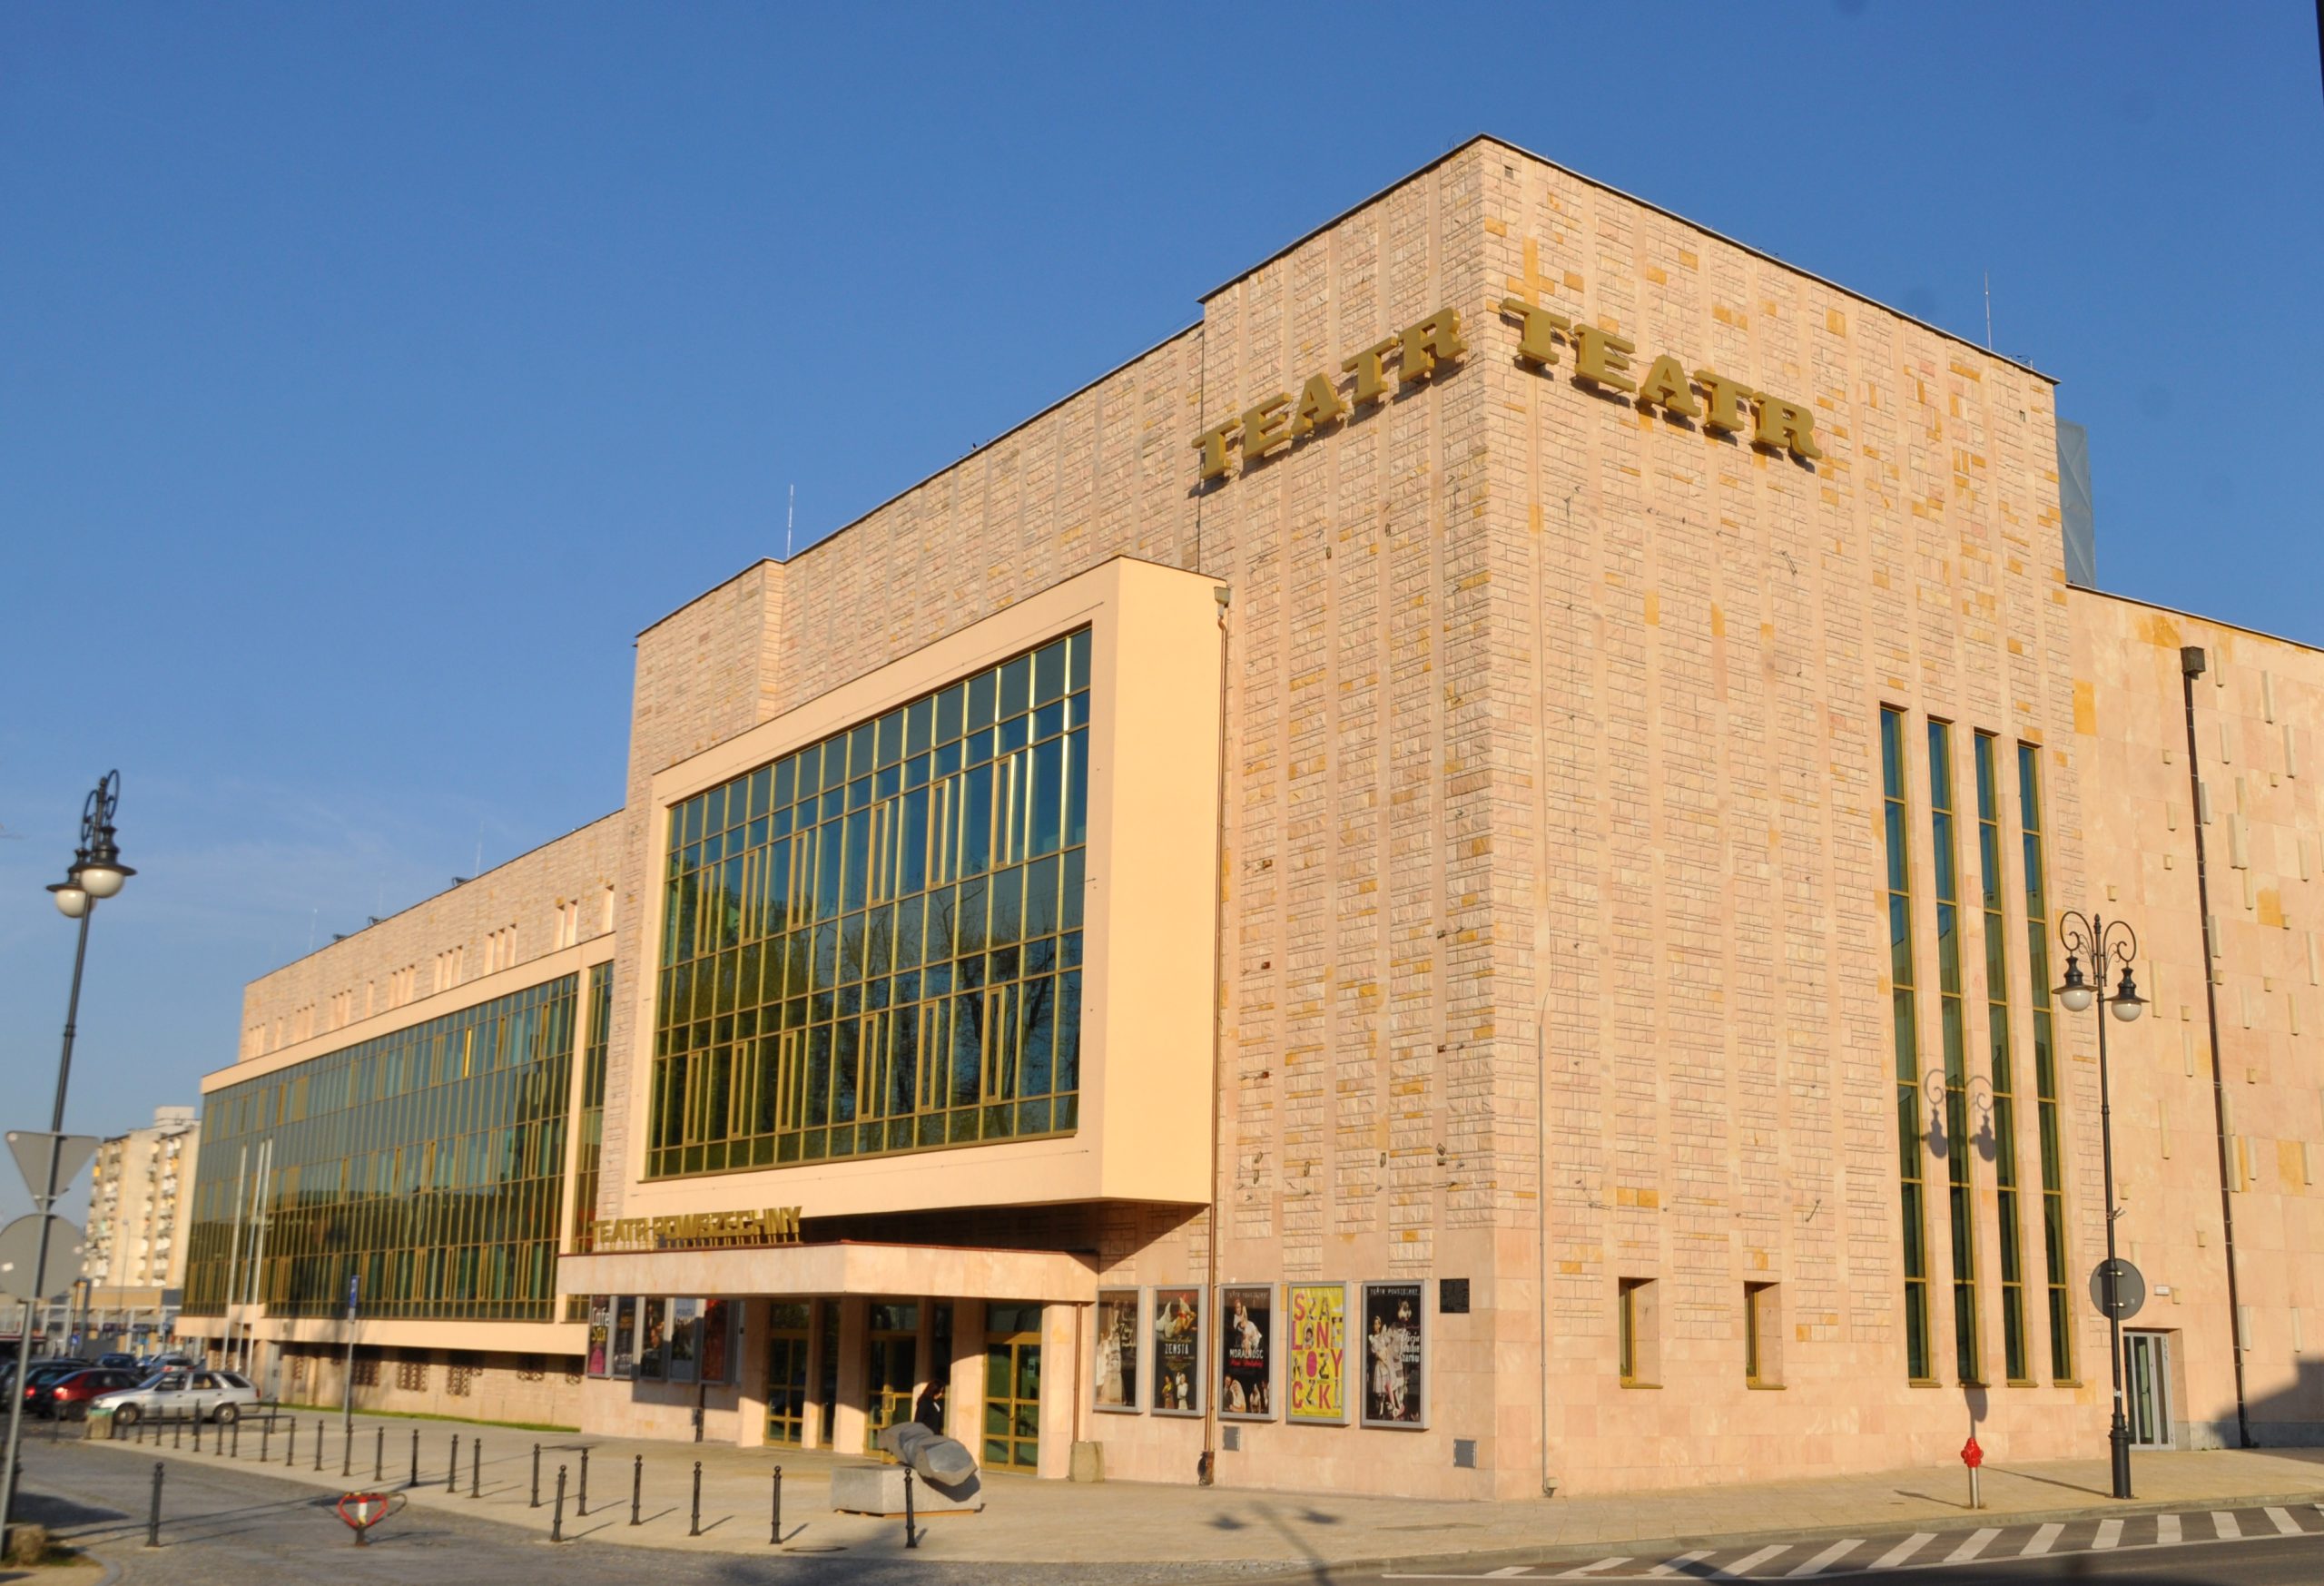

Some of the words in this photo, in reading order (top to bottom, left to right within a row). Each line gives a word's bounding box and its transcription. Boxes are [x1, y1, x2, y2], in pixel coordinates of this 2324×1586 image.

[1192, 307, 1469, 481] TEATR
[1502, 297, 1823, 460] TEATR
[588, 1217, 651, 1243] TEATR
[653, 1206, 803, 1240] POWSZECHNY
